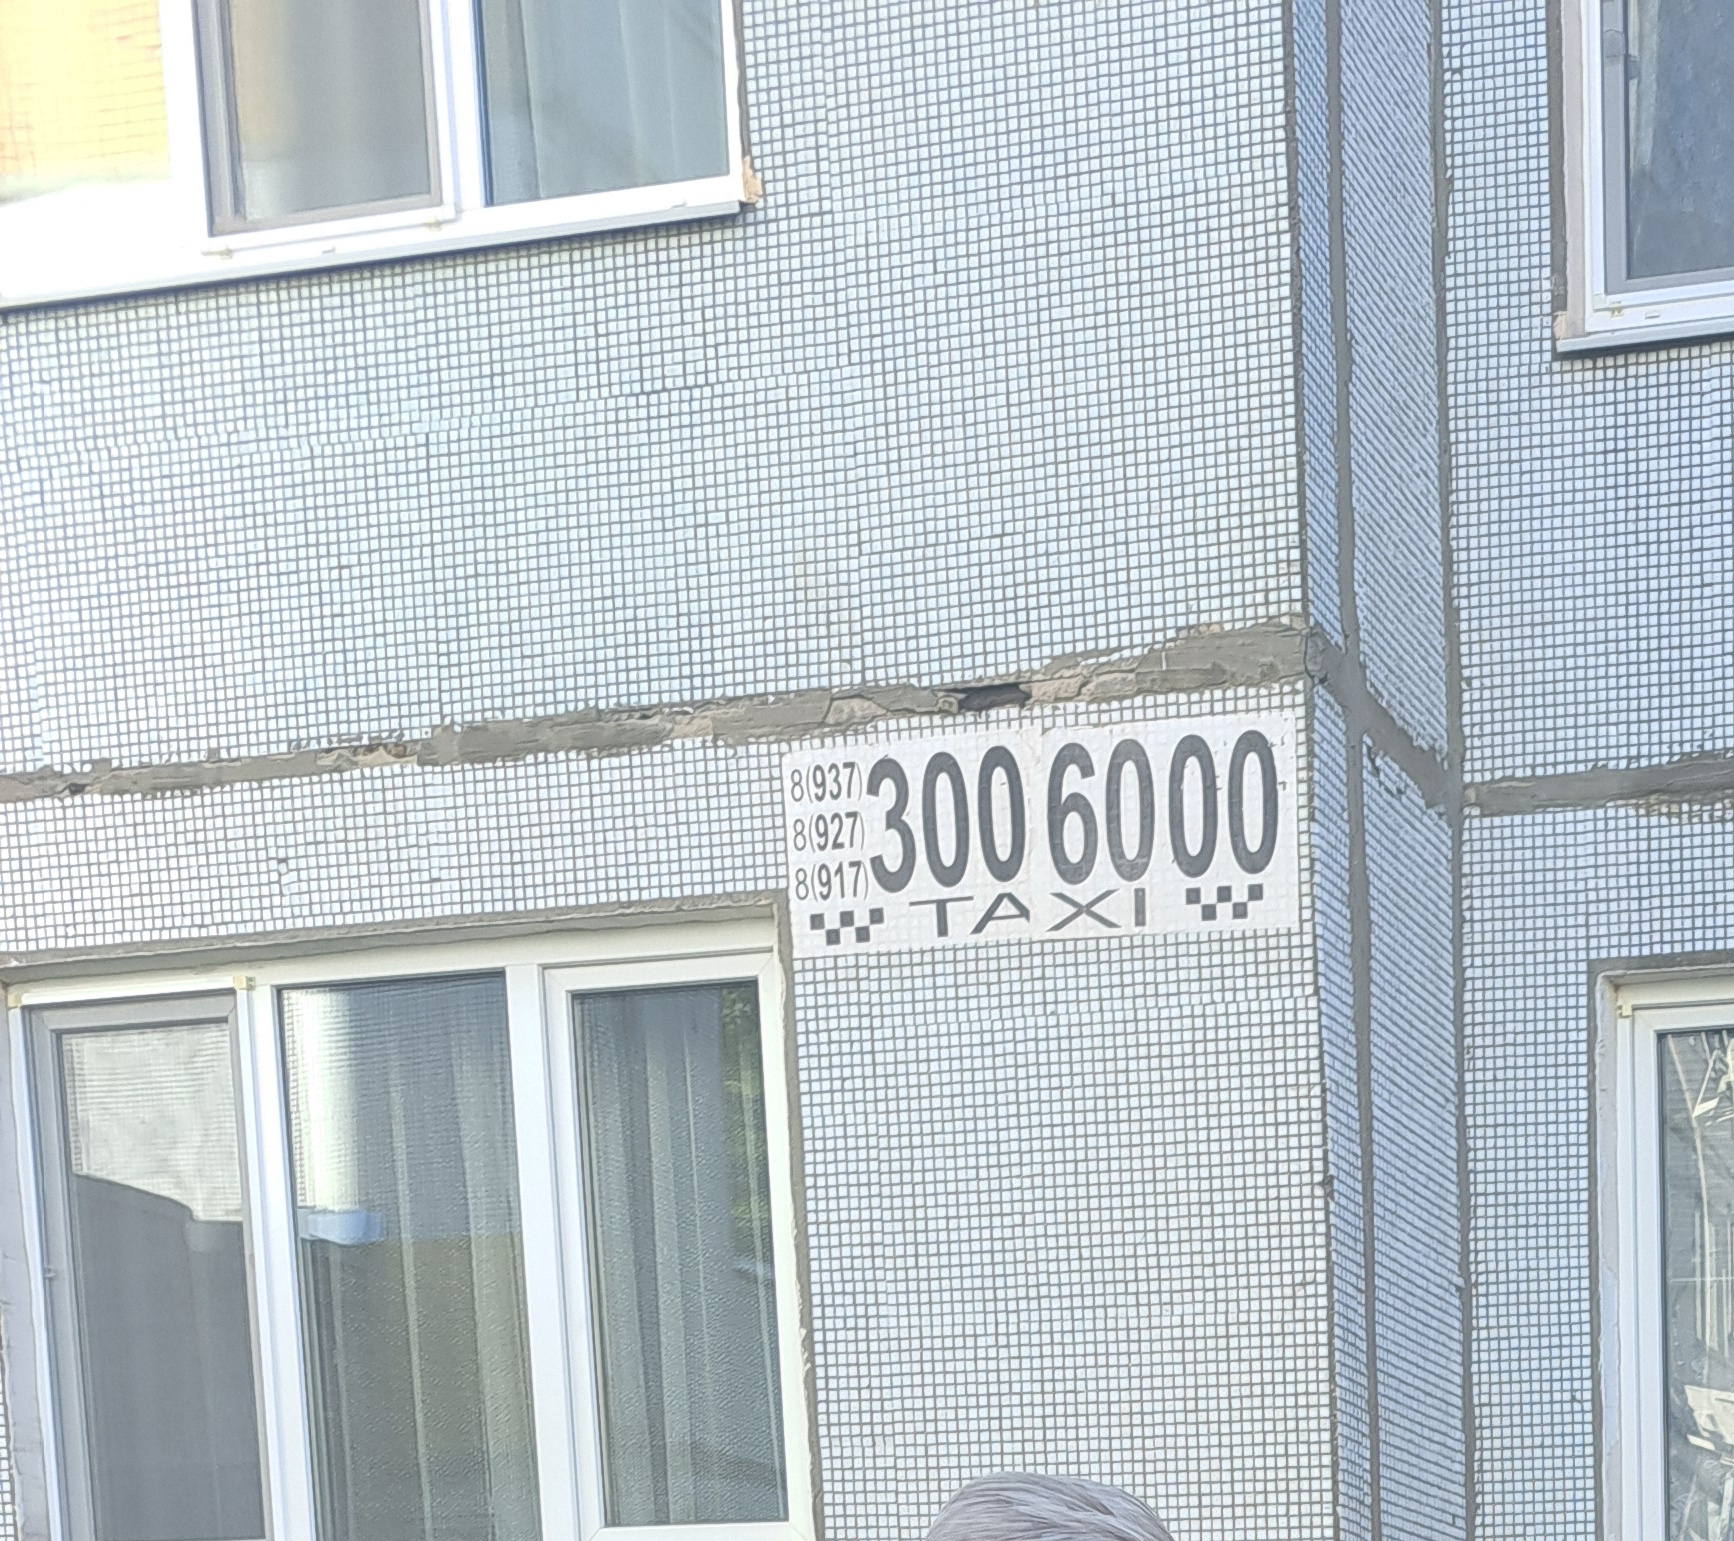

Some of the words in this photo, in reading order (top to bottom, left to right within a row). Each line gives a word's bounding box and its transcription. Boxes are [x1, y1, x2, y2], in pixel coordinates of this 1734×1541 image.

[790, 761, 863, 804] 8(937)
[793, 811, 865, 853] 8(927)
[795, 860, 869, 902] 8(917)
[908, 887, 1147, 938] TAXI
